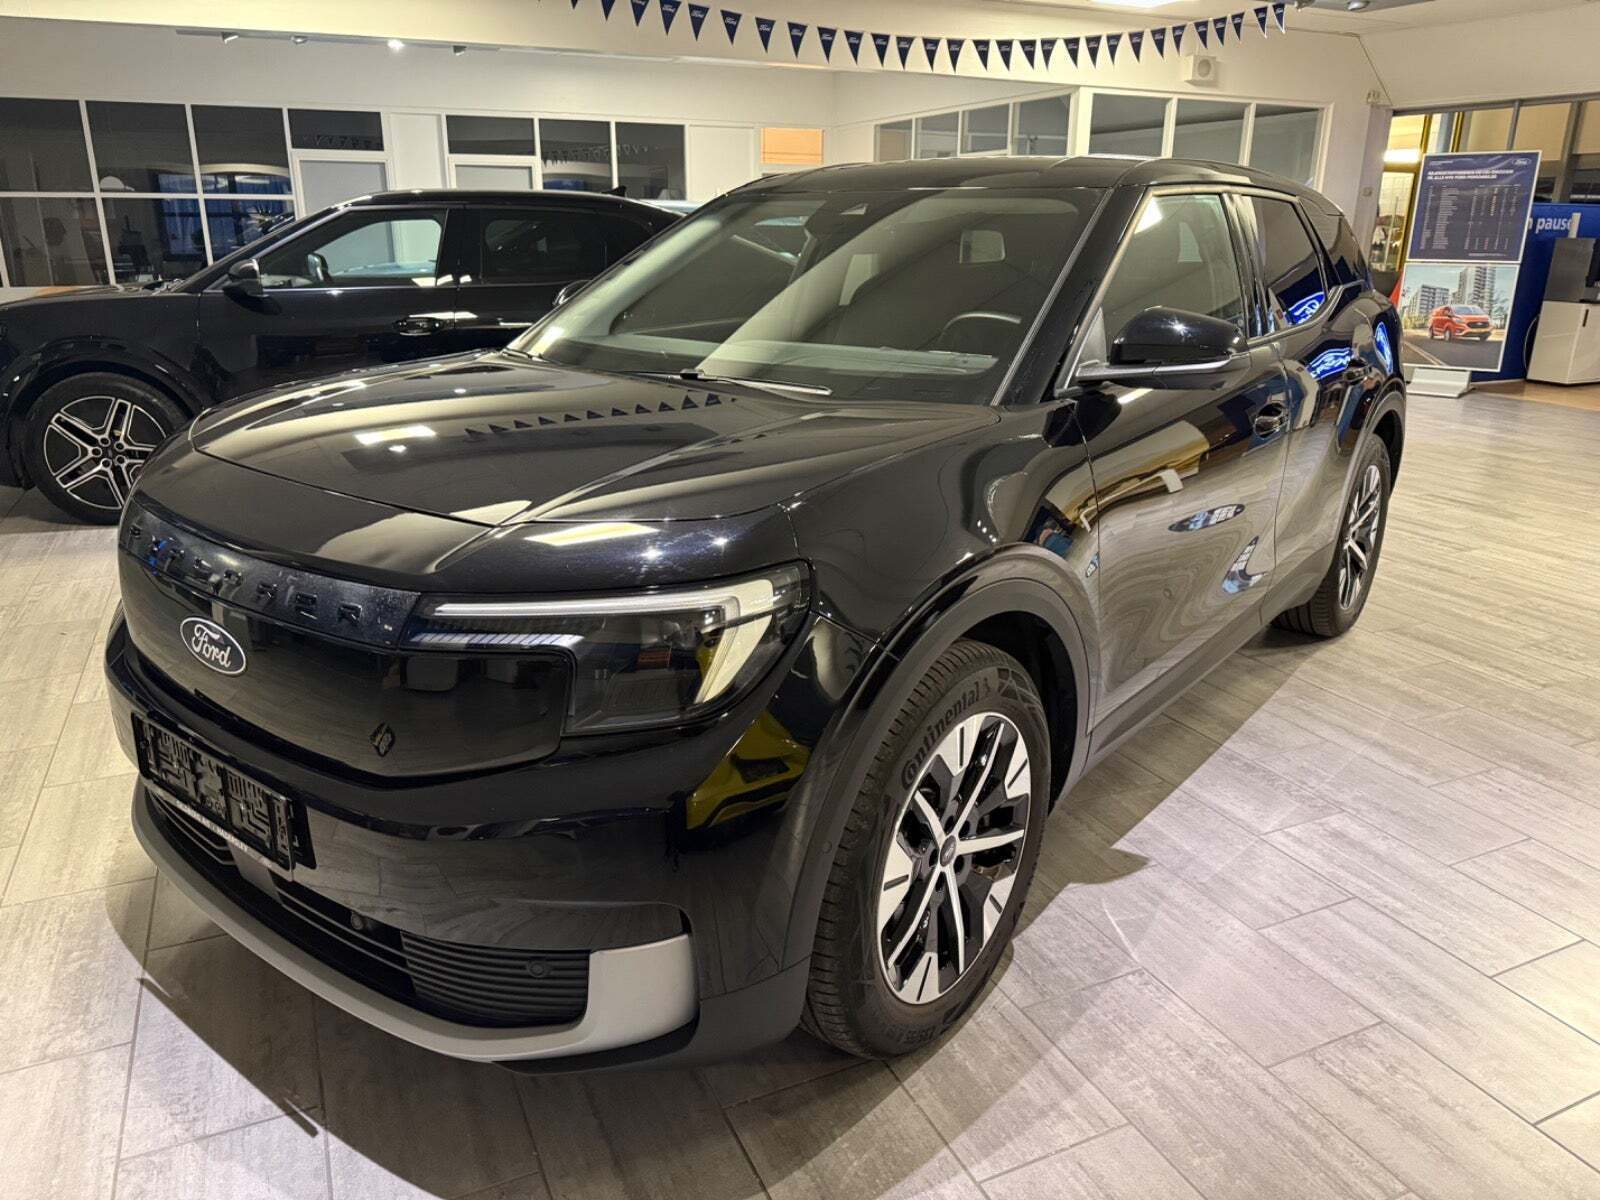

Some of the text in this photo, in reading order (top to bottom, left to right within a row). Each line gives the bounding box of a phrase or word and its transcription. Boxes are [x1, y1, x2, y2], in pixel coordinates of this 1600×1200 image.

[760, 24, 771, 32] Ford
[190, 623, 233, 669] Ford
[902, 681, 980, 791] Continental
